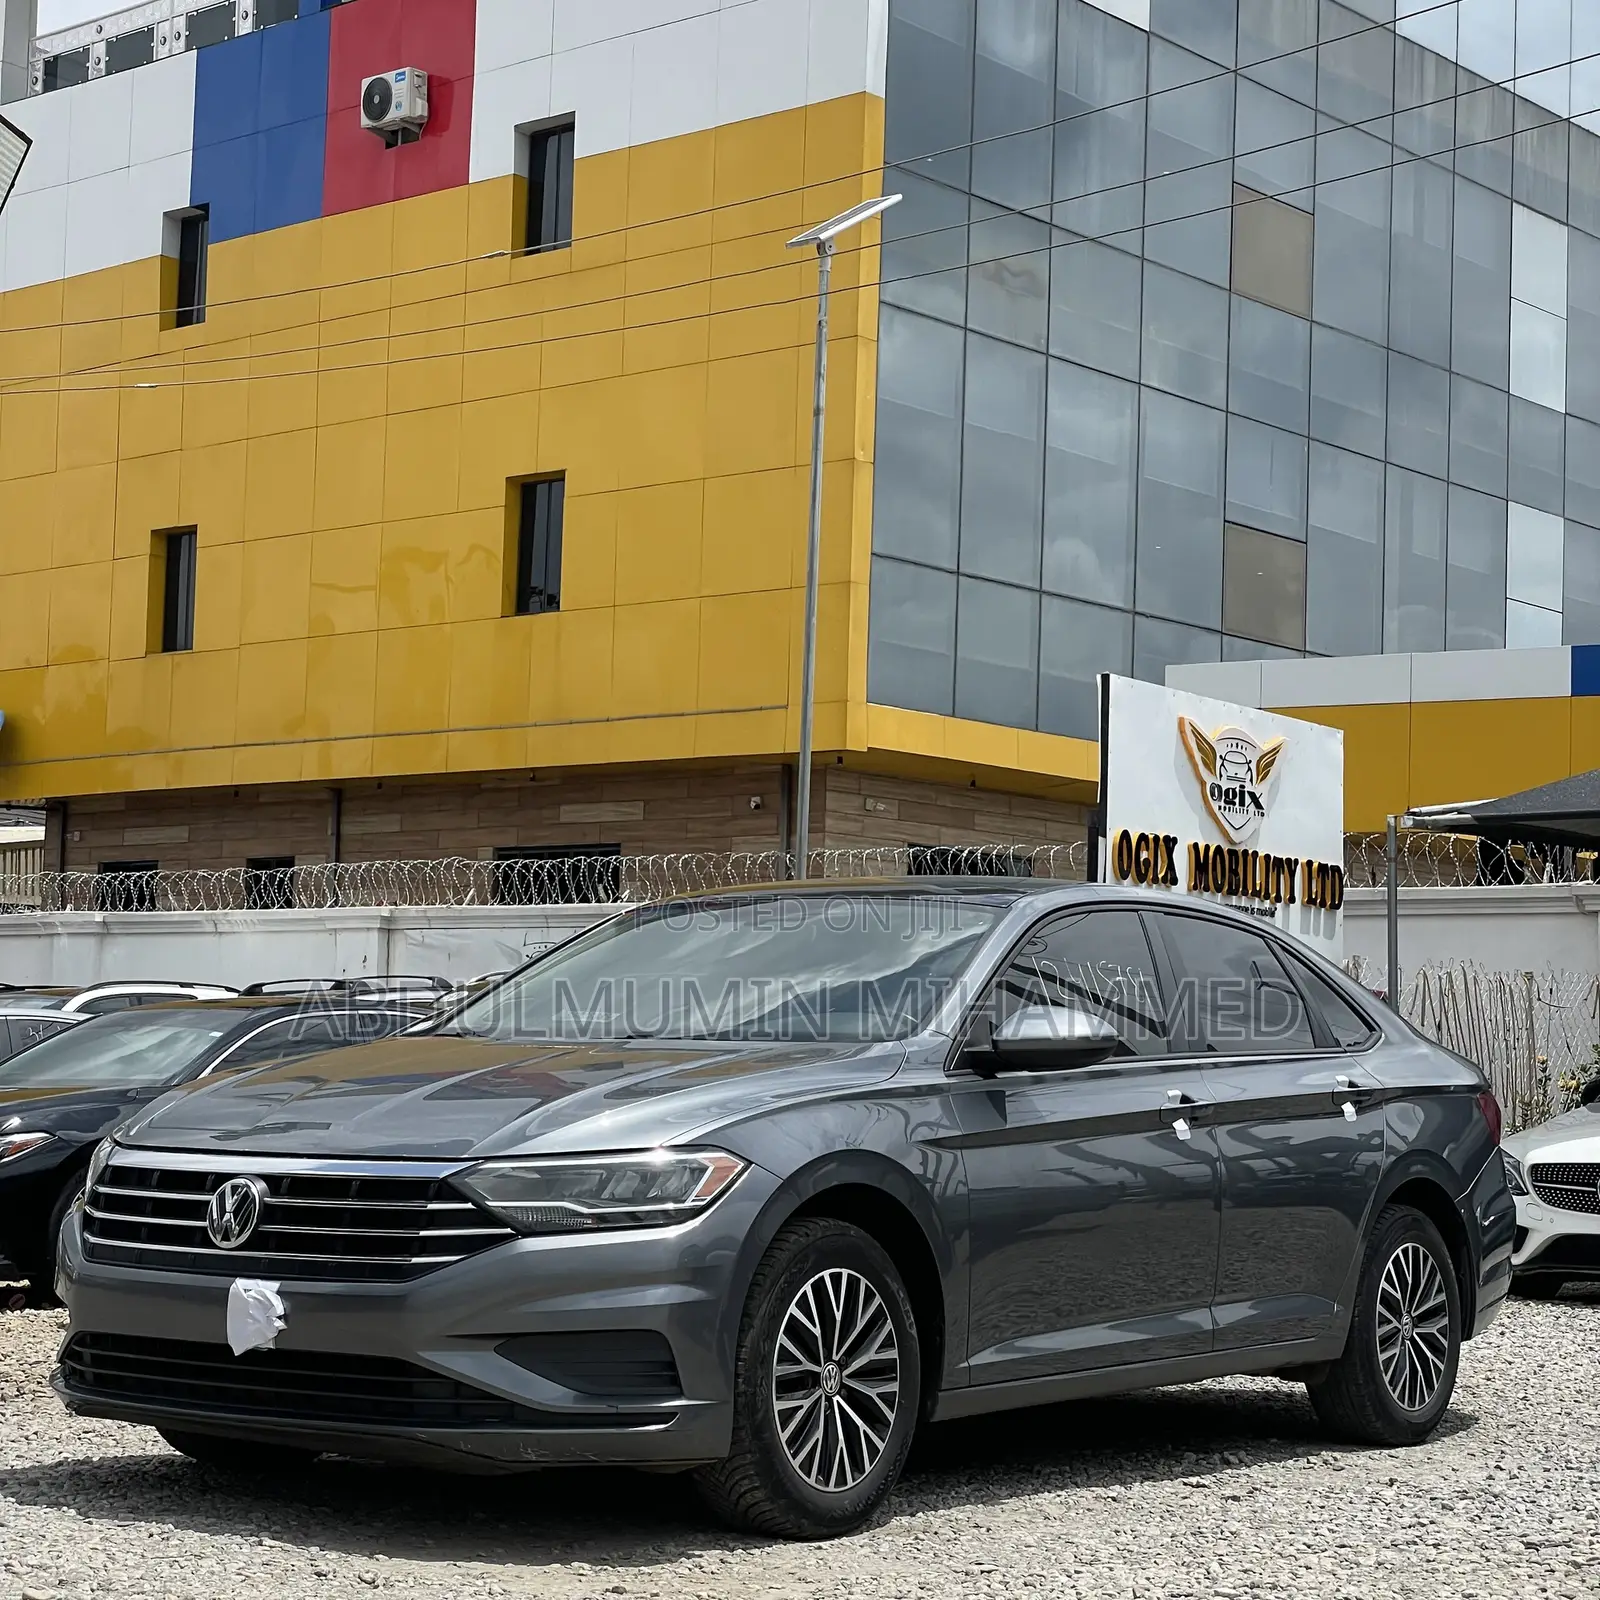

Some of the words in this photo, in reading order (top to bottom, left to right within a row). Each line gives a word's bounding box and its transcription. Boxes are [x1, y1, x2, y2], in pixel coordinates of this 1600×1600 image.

[1113, 828, 1179, 887] OGIX
[1187, 841, 1299, 904] MOBILITY
[1301, 859, 1344, 911] LTD
